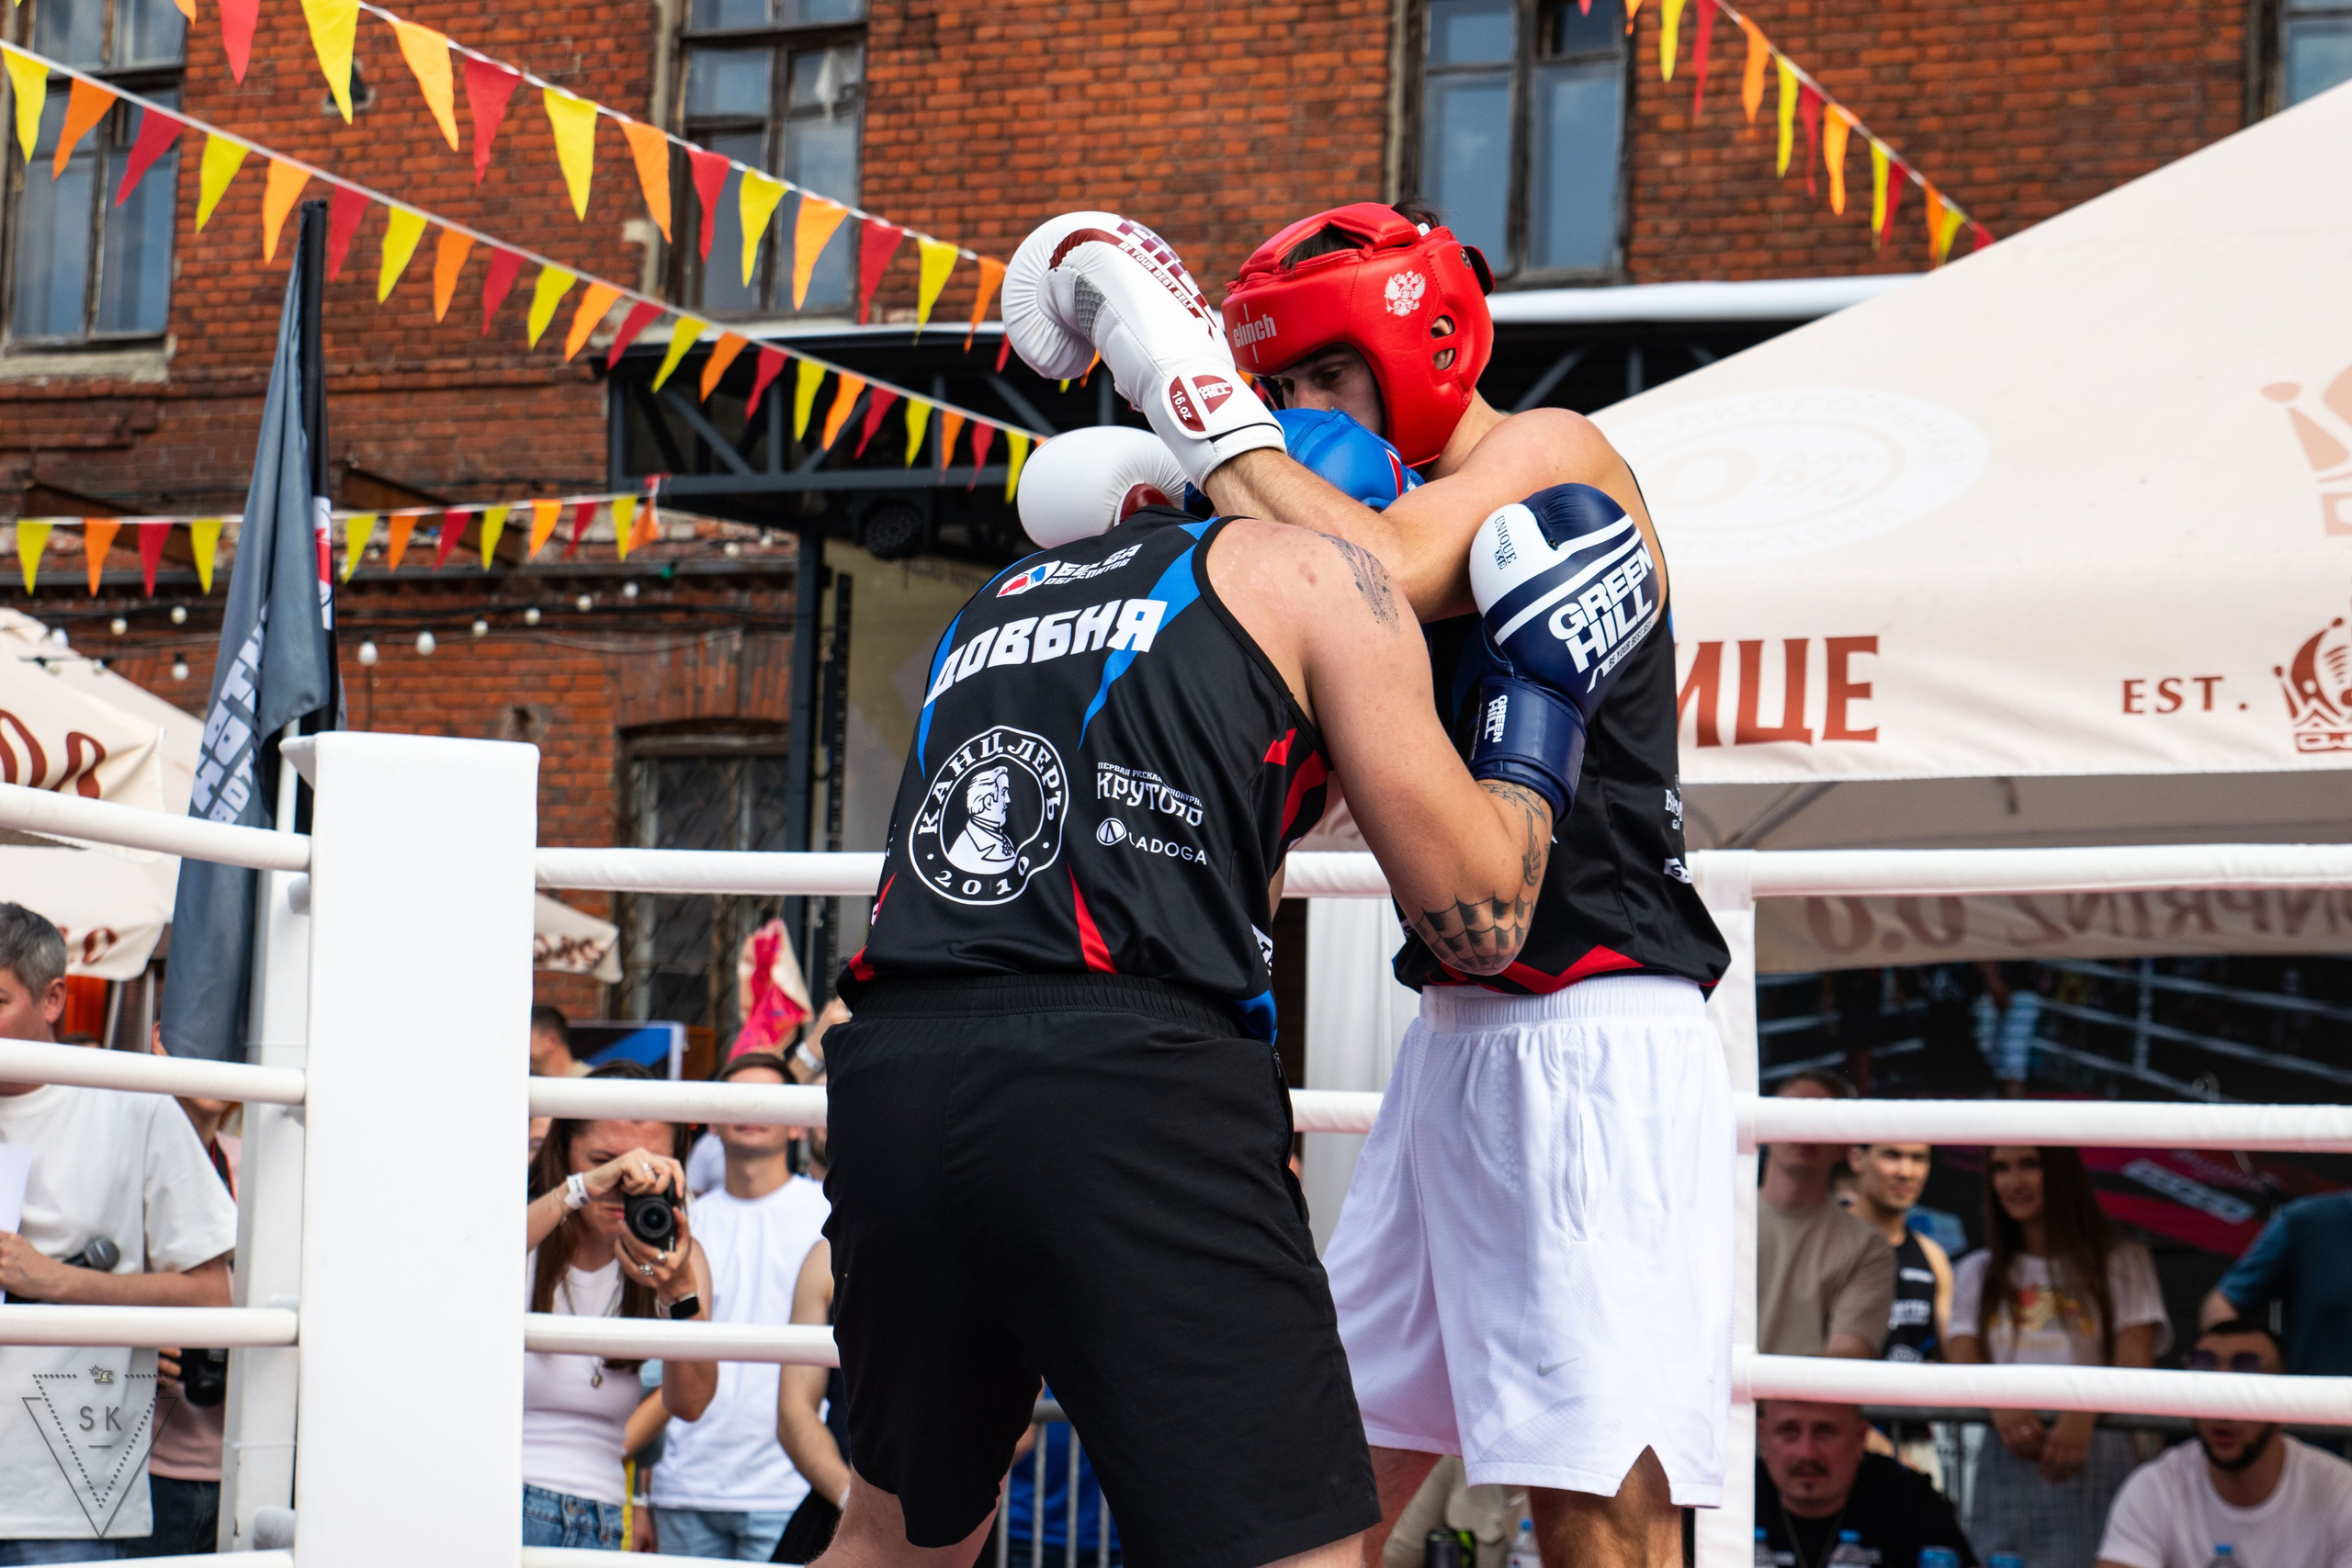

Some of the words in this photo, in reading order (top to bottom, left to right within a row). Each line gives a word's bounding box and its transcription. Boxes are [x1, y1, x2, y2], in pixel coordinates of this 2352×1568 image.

[1118, 241, 1132, 253] BE
[1131, 248, 1156, 273] YOUR
[1152, 268, 1177, 290] BEST
[1173, 288, 1194, 310] SELF
[1233, 313, 1277, 348] clinch
[1495, 515, 1517, 564] UNIQUE
[1548, 541, 1653, 640] GREEN
[923, 598, 1168, 708] ДОВБНЯ
[1566, 585, 1652, 673] HILL
[1617, 640, 1631, 660] YOUR
[1484, 699, 1499, 739] HILL
[1492, 694, 1509, 743] GREEN
[2121, 675, 2248, 715] EST.
[919, 732, 1062, 834] КАНЦЛЕРЪ
[1098, 762, 1131, 776] ПЕРВАЯ
[934, 856, 1030, 895] 2010
